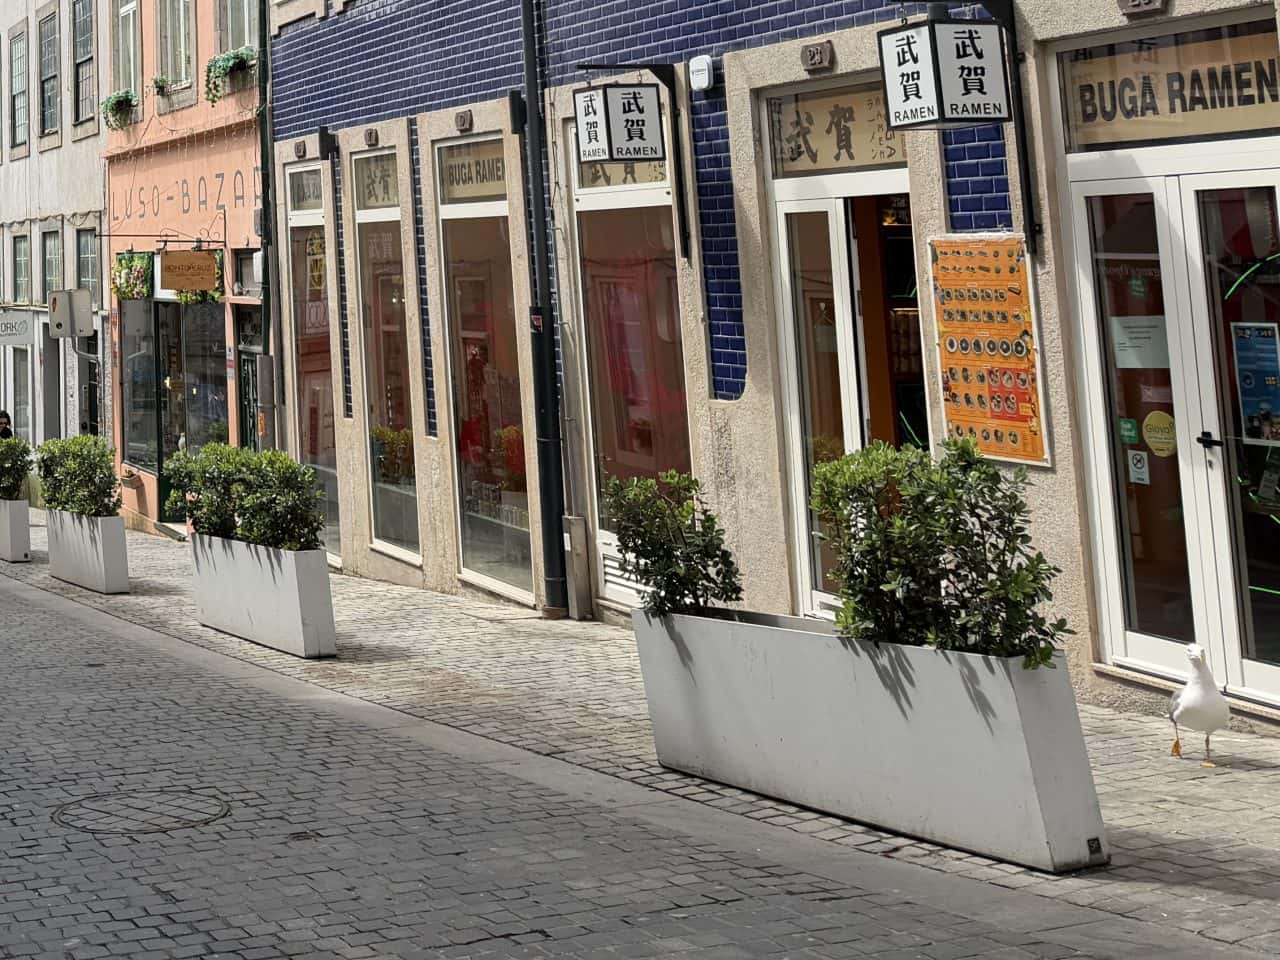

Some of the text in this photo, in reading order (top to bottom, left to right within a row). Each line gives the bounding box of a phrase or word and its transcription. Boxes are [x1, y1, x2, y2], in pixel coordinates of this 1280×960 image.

[895, 34, 923, 103] 武賀
[953, 28, 988, 97] 武賀
[1079, 58, 1280, 123] BUGA RAMEN
[620, 90, 647, 142] 武賀
[894, 105, 935, 124] RAMEN
[950, 102, 1002, 115] RAMEN
[582, 147, 607, 158] RAMEN
[616, 146, 658, 156] RAMEN
[447, 160, 474, 186] BUGA
